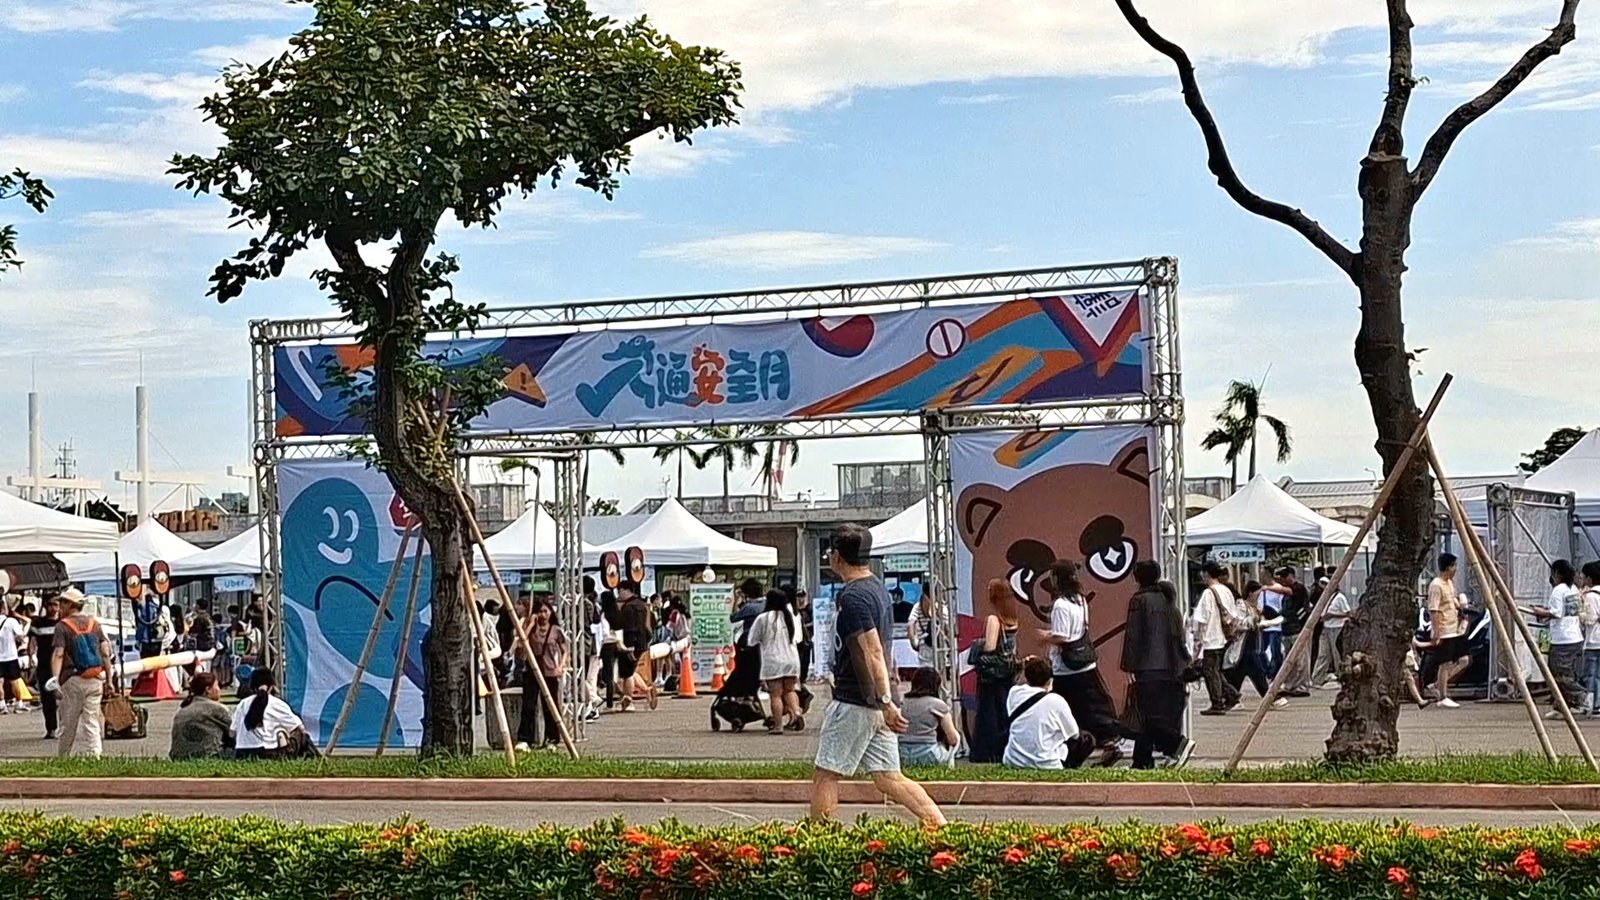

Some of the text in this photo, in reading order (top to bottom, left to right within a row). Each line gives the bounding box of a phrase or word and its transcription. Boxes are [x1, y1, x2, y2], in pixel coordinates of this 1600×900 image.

[575, 334, 791, 418] 交通安全月
[224, 579, 245, 588] Uber
